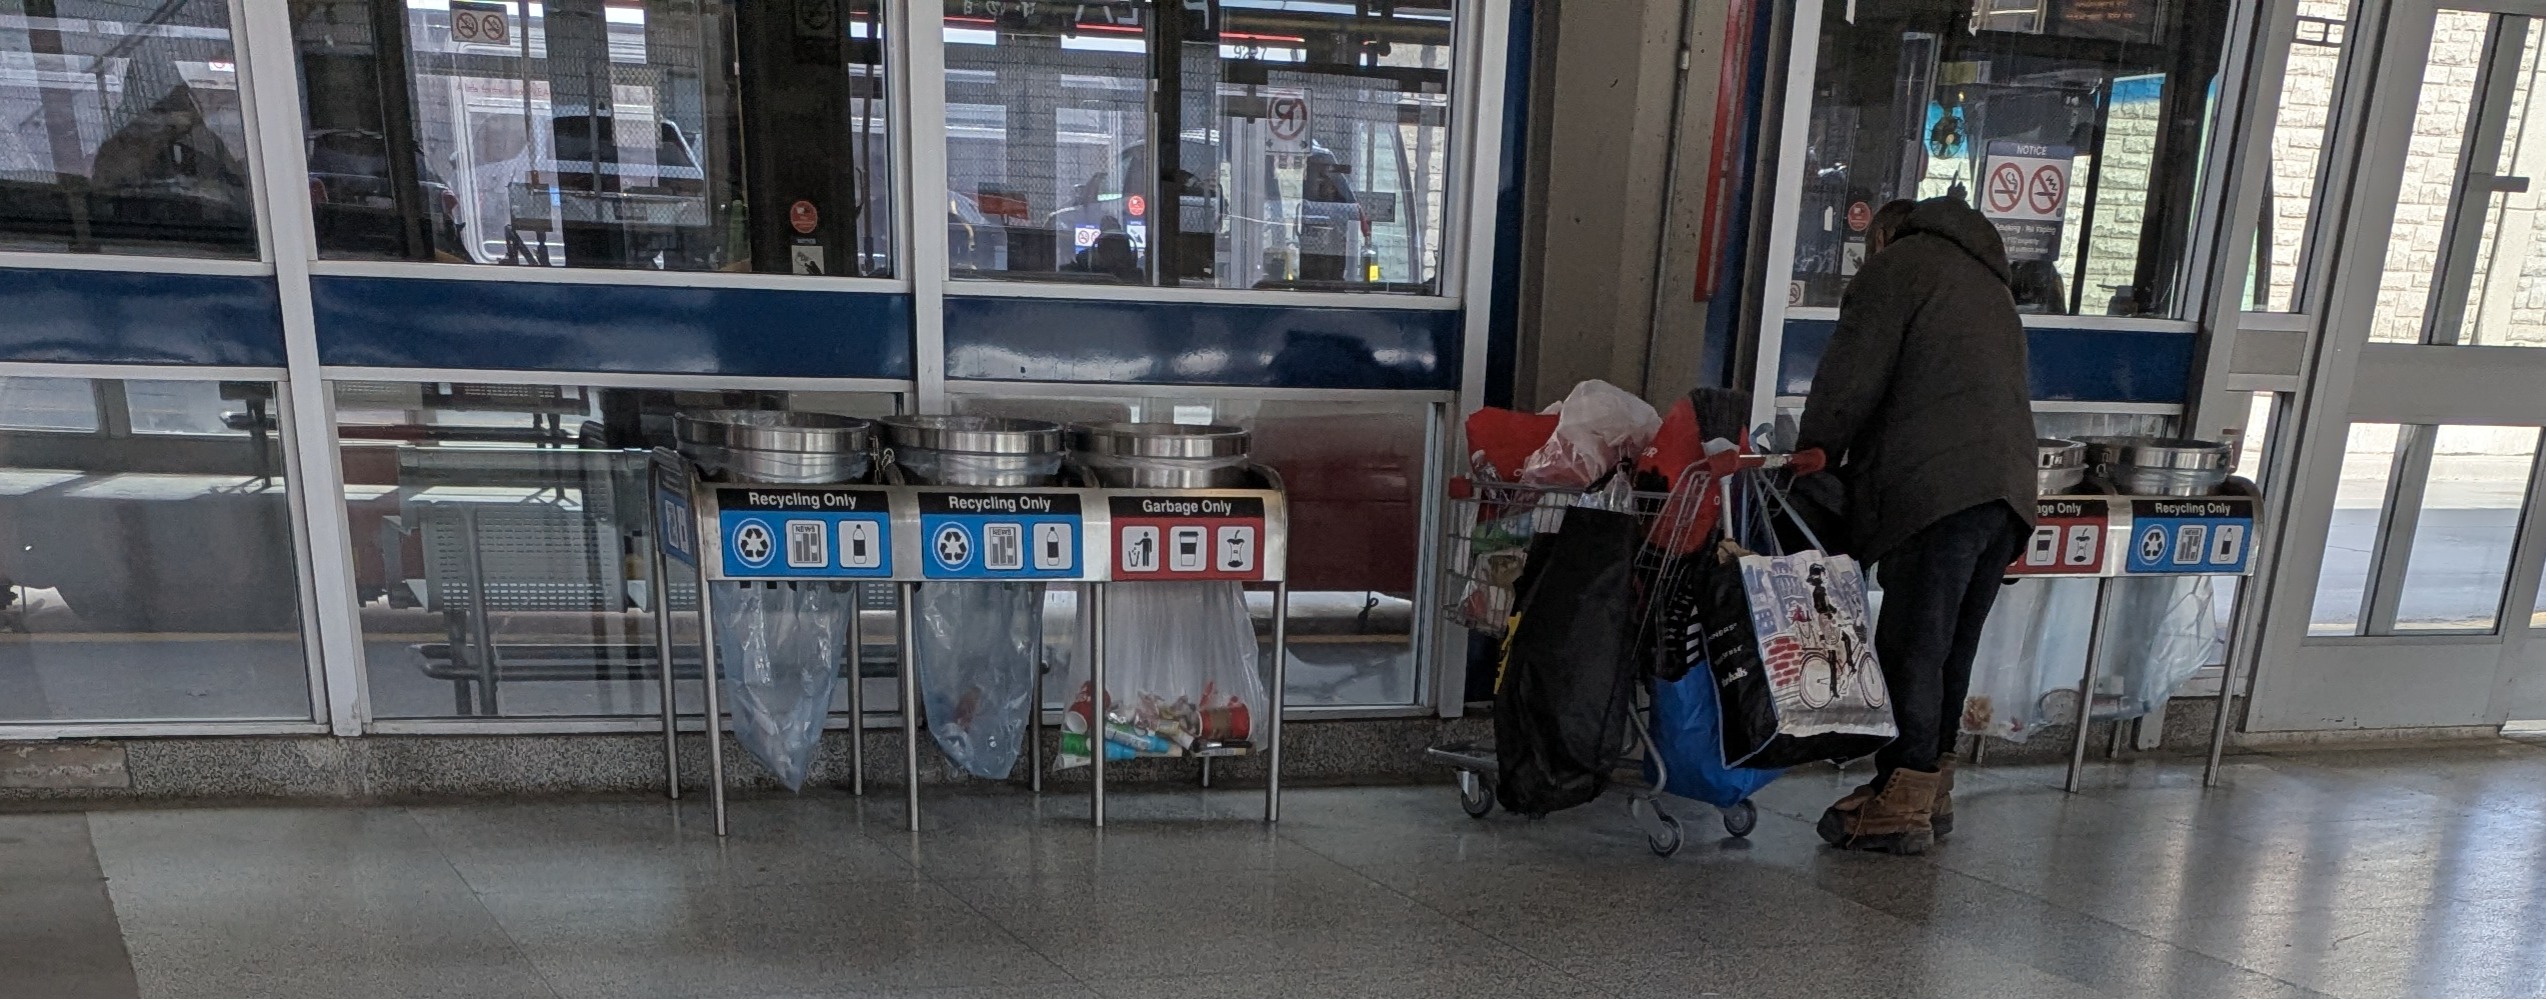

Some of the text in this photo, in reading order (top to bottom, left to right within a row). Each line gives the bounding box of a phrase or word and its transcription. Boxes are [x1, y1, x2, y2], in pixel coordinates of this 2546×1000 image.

[2017, 145, 2048, 156] NOTICE
[748, 492, 857, 510] Recycling Only
[948, 495, 1052, 513] Recycling Only
[1142, 499, 1232, 516] Garbage Only
[2057, 502, 2082, 517] Only
[2155, 502, 2231, 517] Recycling Only
[795, 525, 816, 533] NEWS
